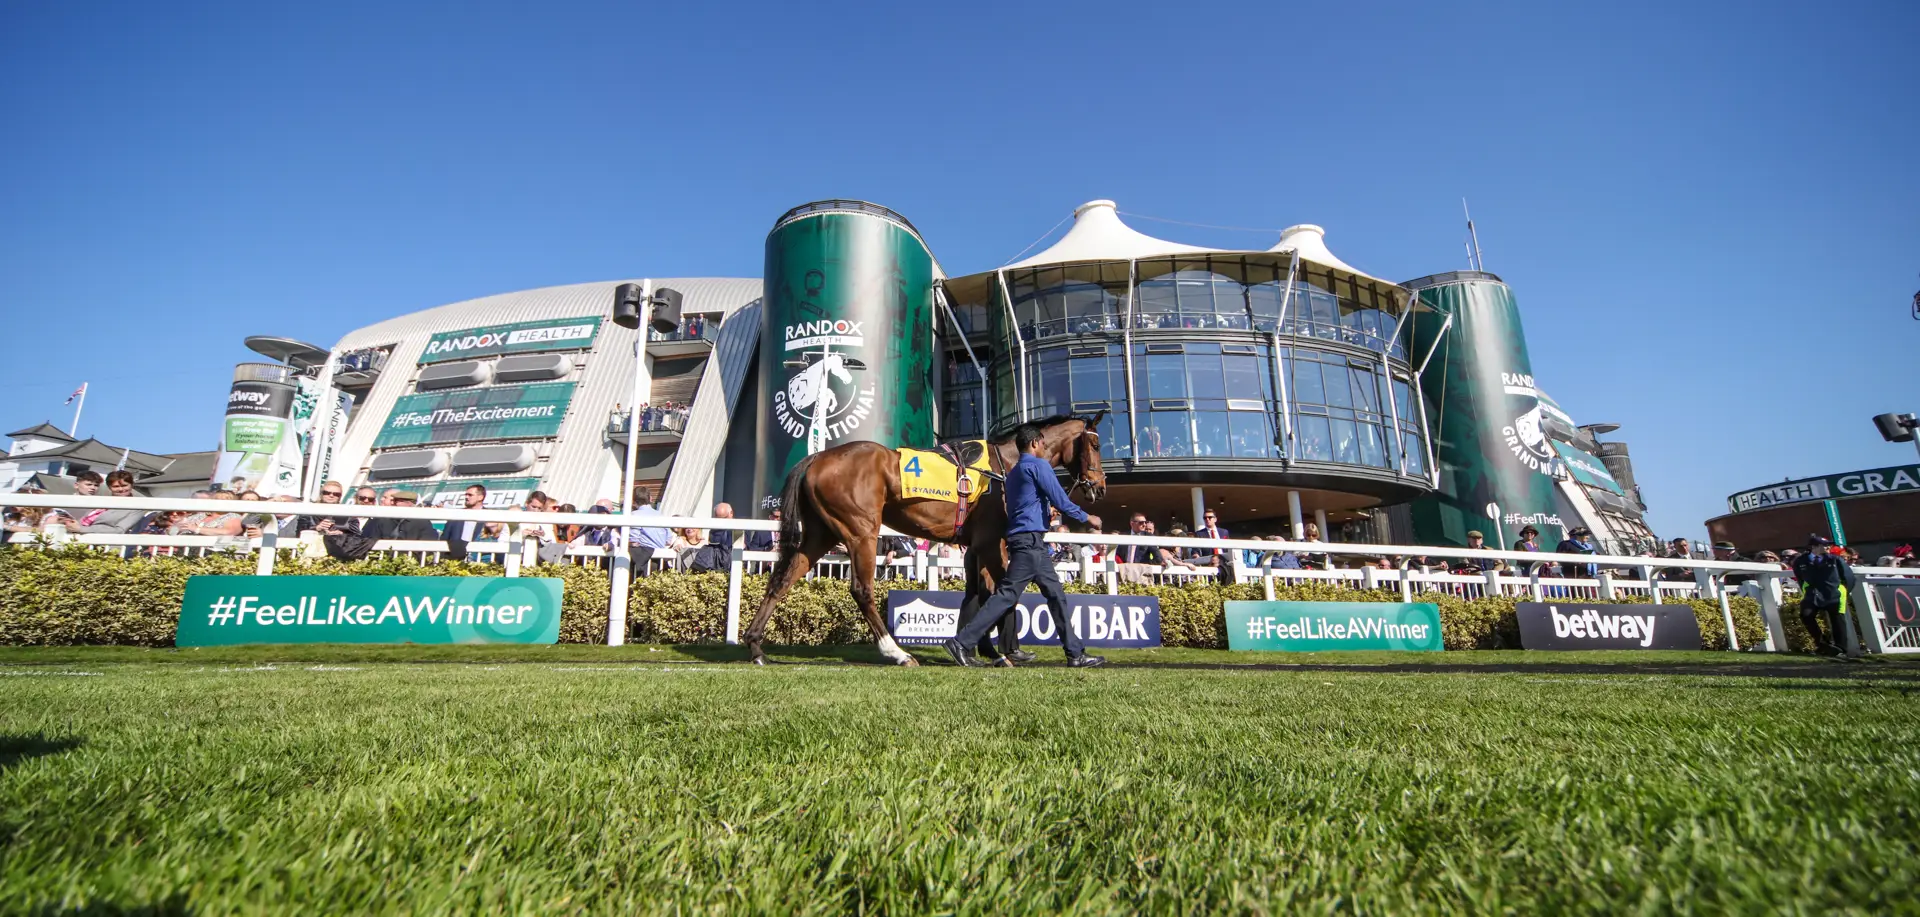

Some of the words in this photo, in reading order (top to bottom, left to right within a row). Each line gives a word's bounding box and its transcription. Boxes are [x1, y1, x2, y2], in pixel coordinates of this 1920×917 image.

[426, 331, 509, 354] RANDOX
[517, 327, 584, 342] HEALTH
[785, 320, 864, 340] RANDOX
[229, 390, 271, 405] etway
[329, 395, 346, 444] RANDOX
[391, 404, 557, 428] #FeelTheExcitement
[775, 391, 805, 438] GRAND
[1503, 426, 1538, 470] GRAND
[904, 456, 923, 477] 4
[912, 487, 951, 496] RYANAIR
[1741, 484, 1814, 509] HEALTH
[1837, 468, 1920, 495] GRA
[208, 596, 533, 626] #FeelLikeAWinner
[899, 612, 955, 625] SHARP'S
[1246, 617, 1429, 639] #FeelLikeAWinner
[1550, 606, 1655, 647] betway
